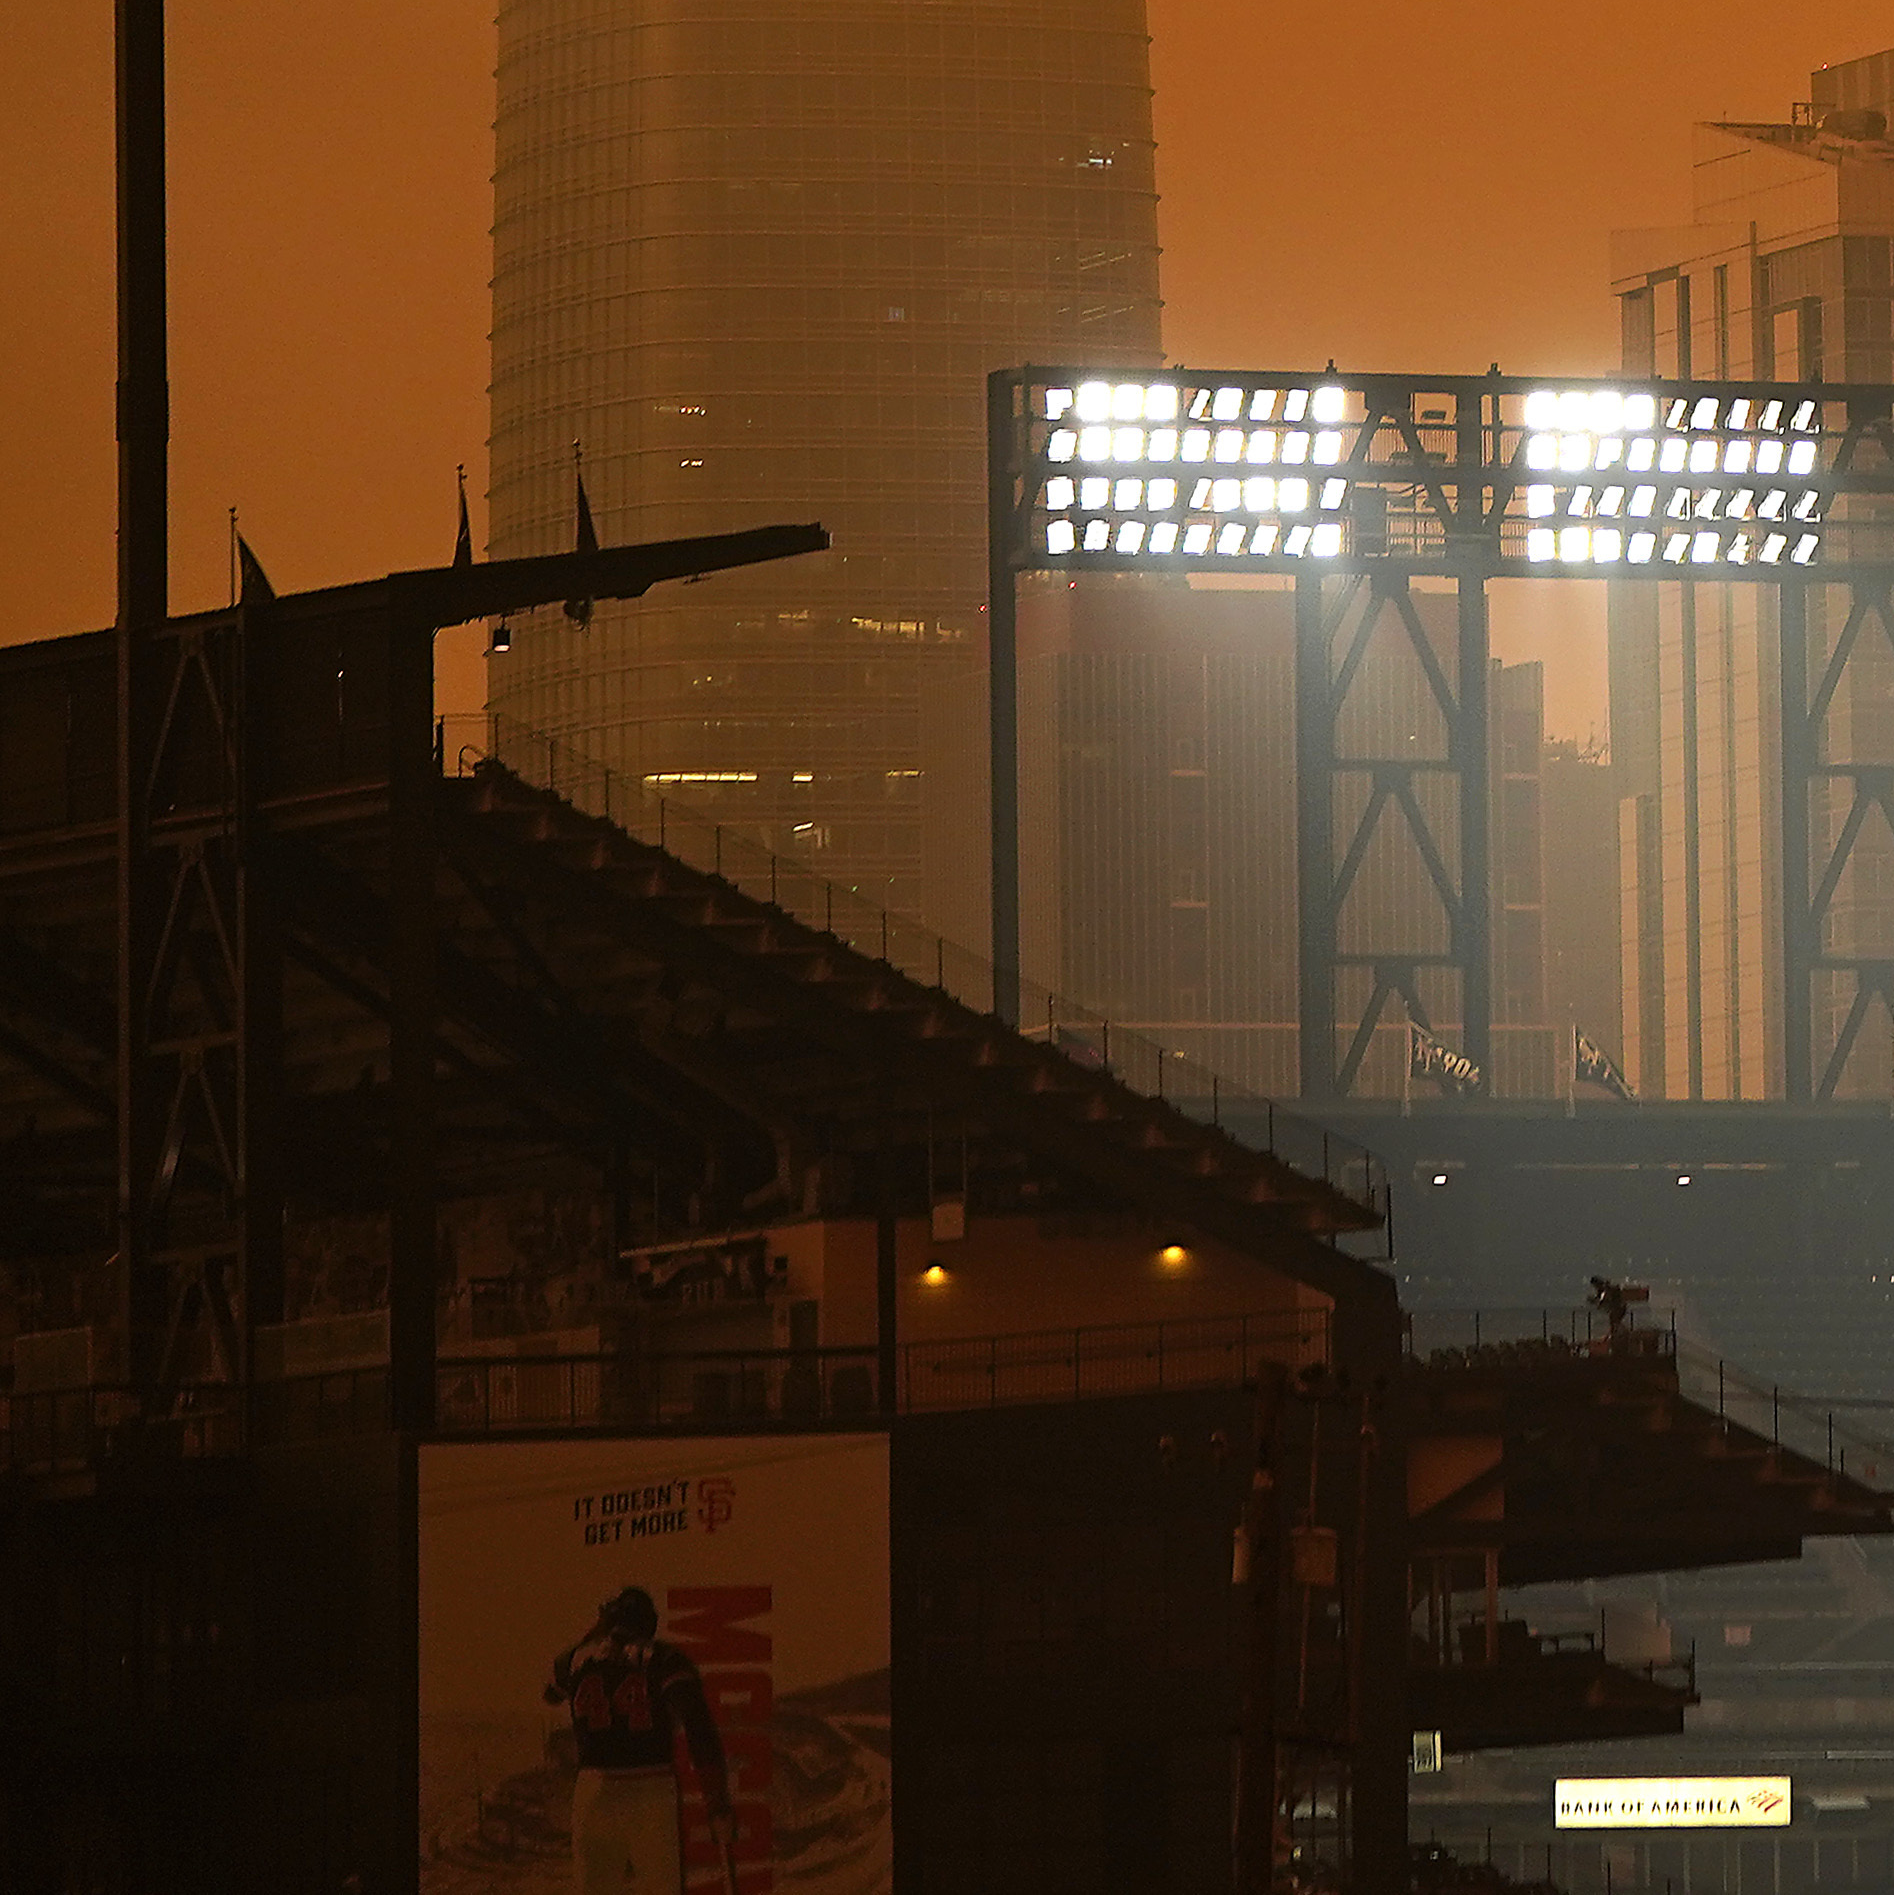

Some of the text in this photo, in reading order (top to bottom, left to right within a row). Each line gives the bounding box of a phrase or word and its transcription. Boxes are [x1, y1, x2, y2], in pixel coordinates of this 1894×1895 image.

[573, 1477, 689, 1521] IT DOESN'T
[584, 1509, 688, 1546] GET MORE
[574, 1672, 653, 1731] 44
[1560, 1798, 1742, 1816] BANK OF AMERICA
